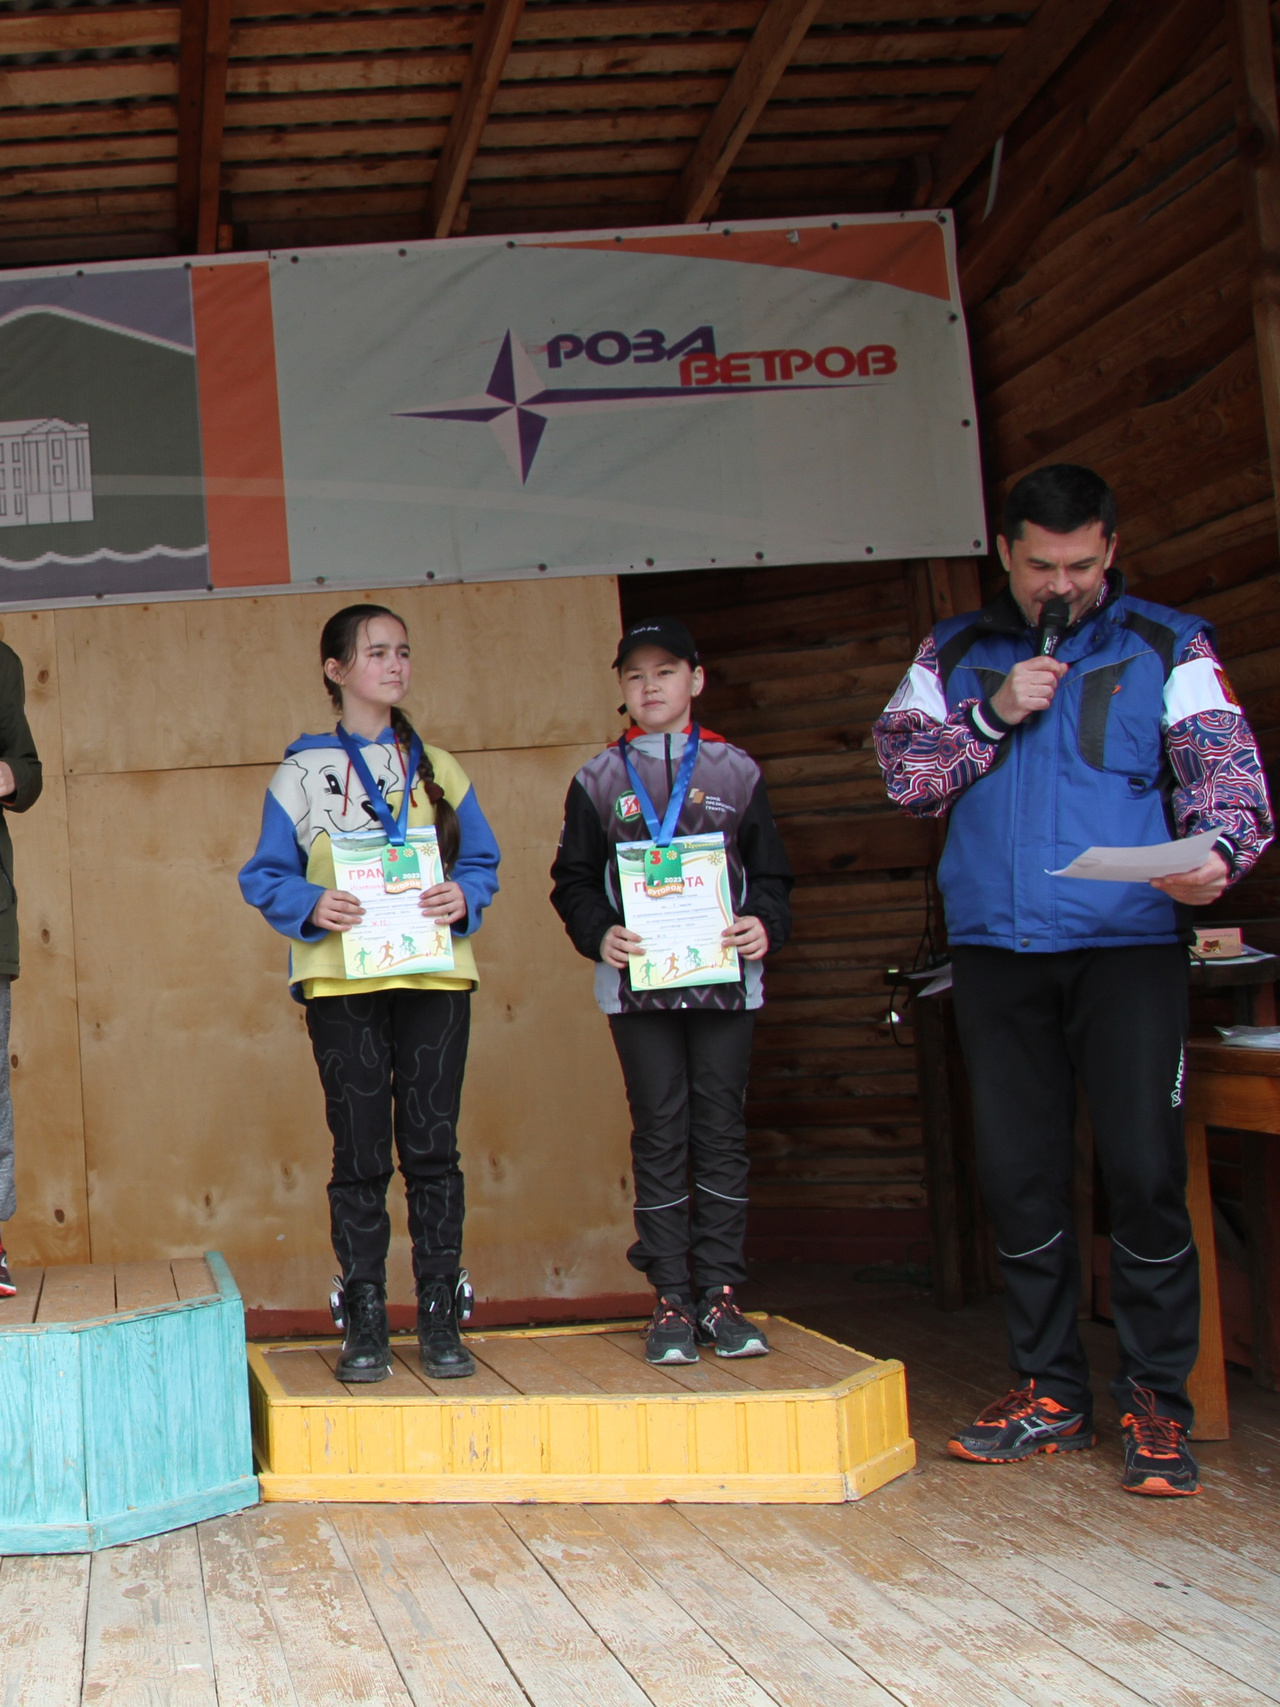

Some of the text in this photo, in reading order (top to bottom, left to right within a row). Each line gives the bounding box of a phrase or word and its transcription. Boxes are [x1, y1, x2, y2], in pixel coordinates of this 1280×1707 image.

[546, 326, 717, 369] РОЗА
[679, 344, 898, 387] ВЕТРОВ
[386, 848, 399, 862] 3
[650, 850, 662, 865] 3
[348, 867, 384, 880] ГРАМ
[402, 872, 420, 880] 2023
[664, 876, 682, 884] 2023
[647, 884, 683, 896] БУГОРОК
